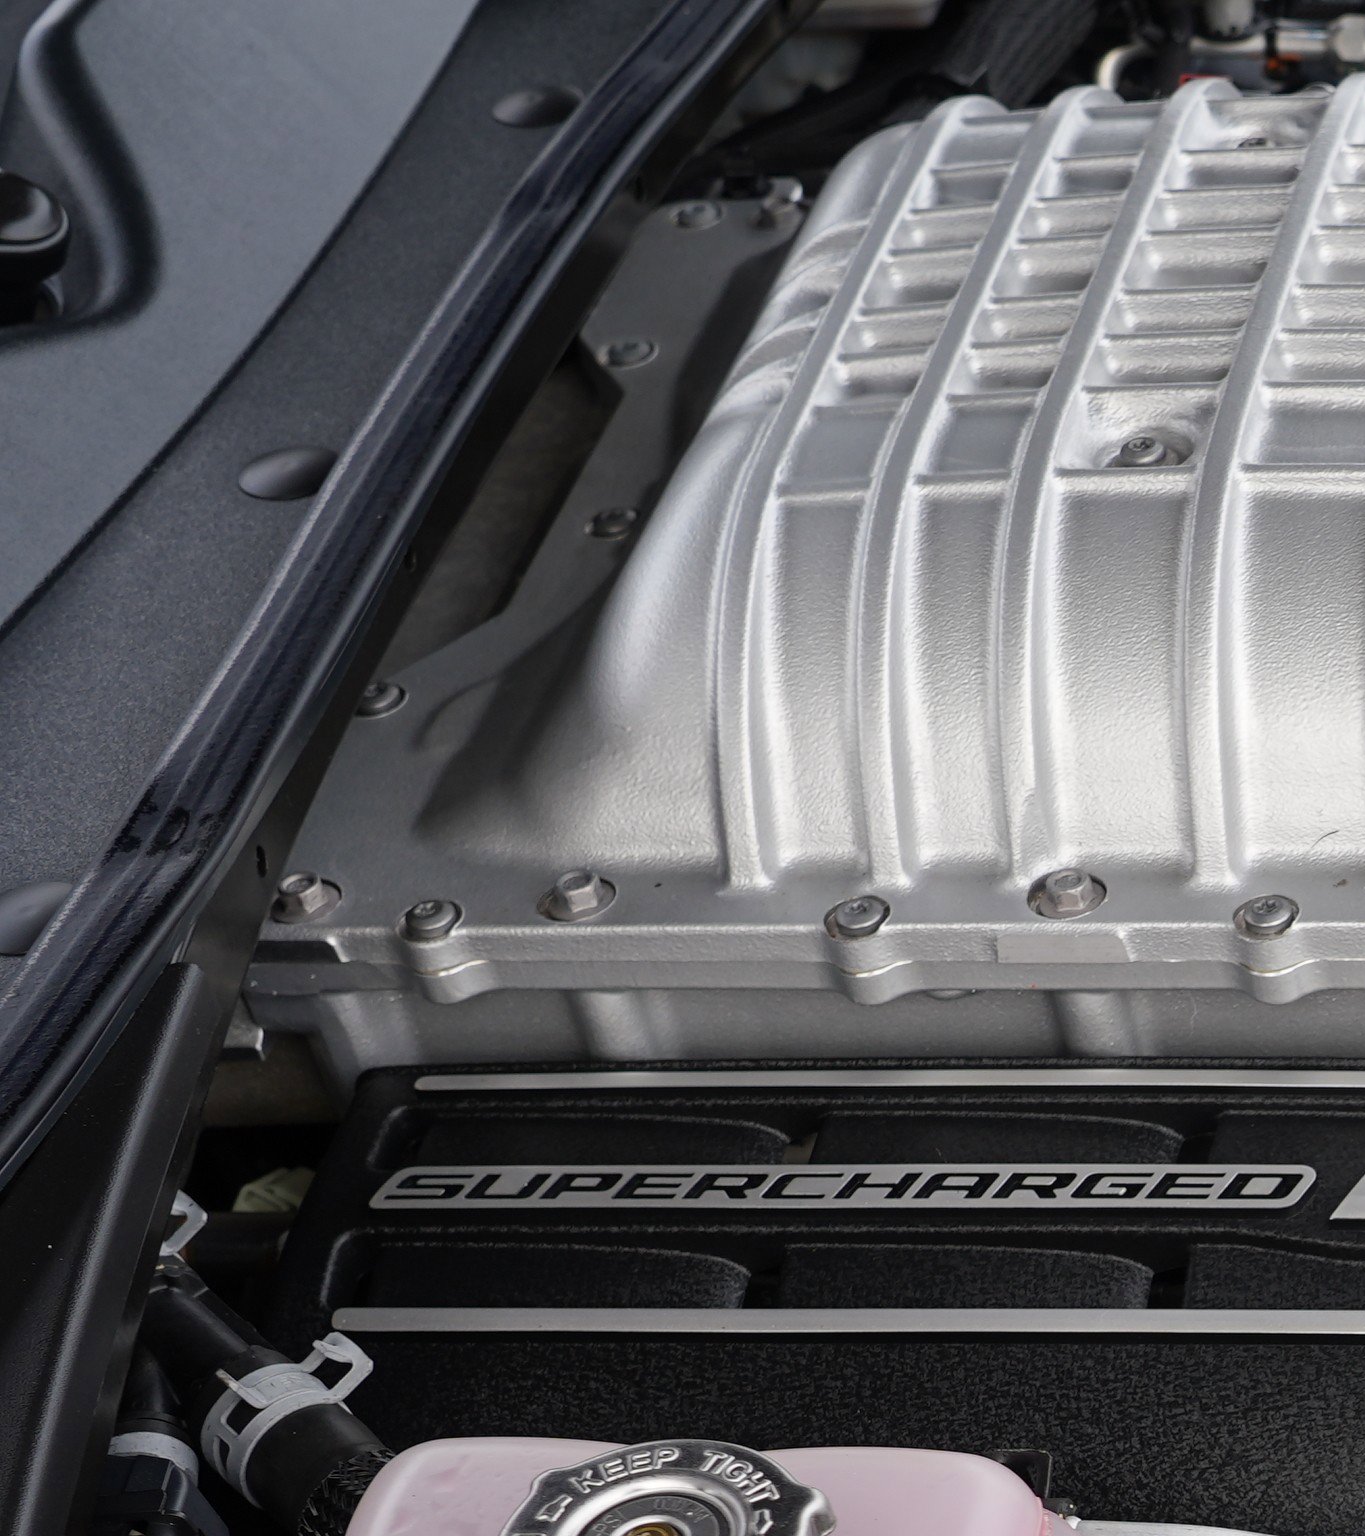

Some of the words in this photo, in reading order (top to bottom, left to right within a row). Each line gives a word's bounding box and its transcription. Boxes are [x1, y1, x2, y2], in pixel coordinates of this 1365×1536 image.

[386, 1168, 1306, 1205] SUPERCHARGED
[569, 1448, 681, 1494] KEEP
[699, 1450, 781, 1503] TIGHT
